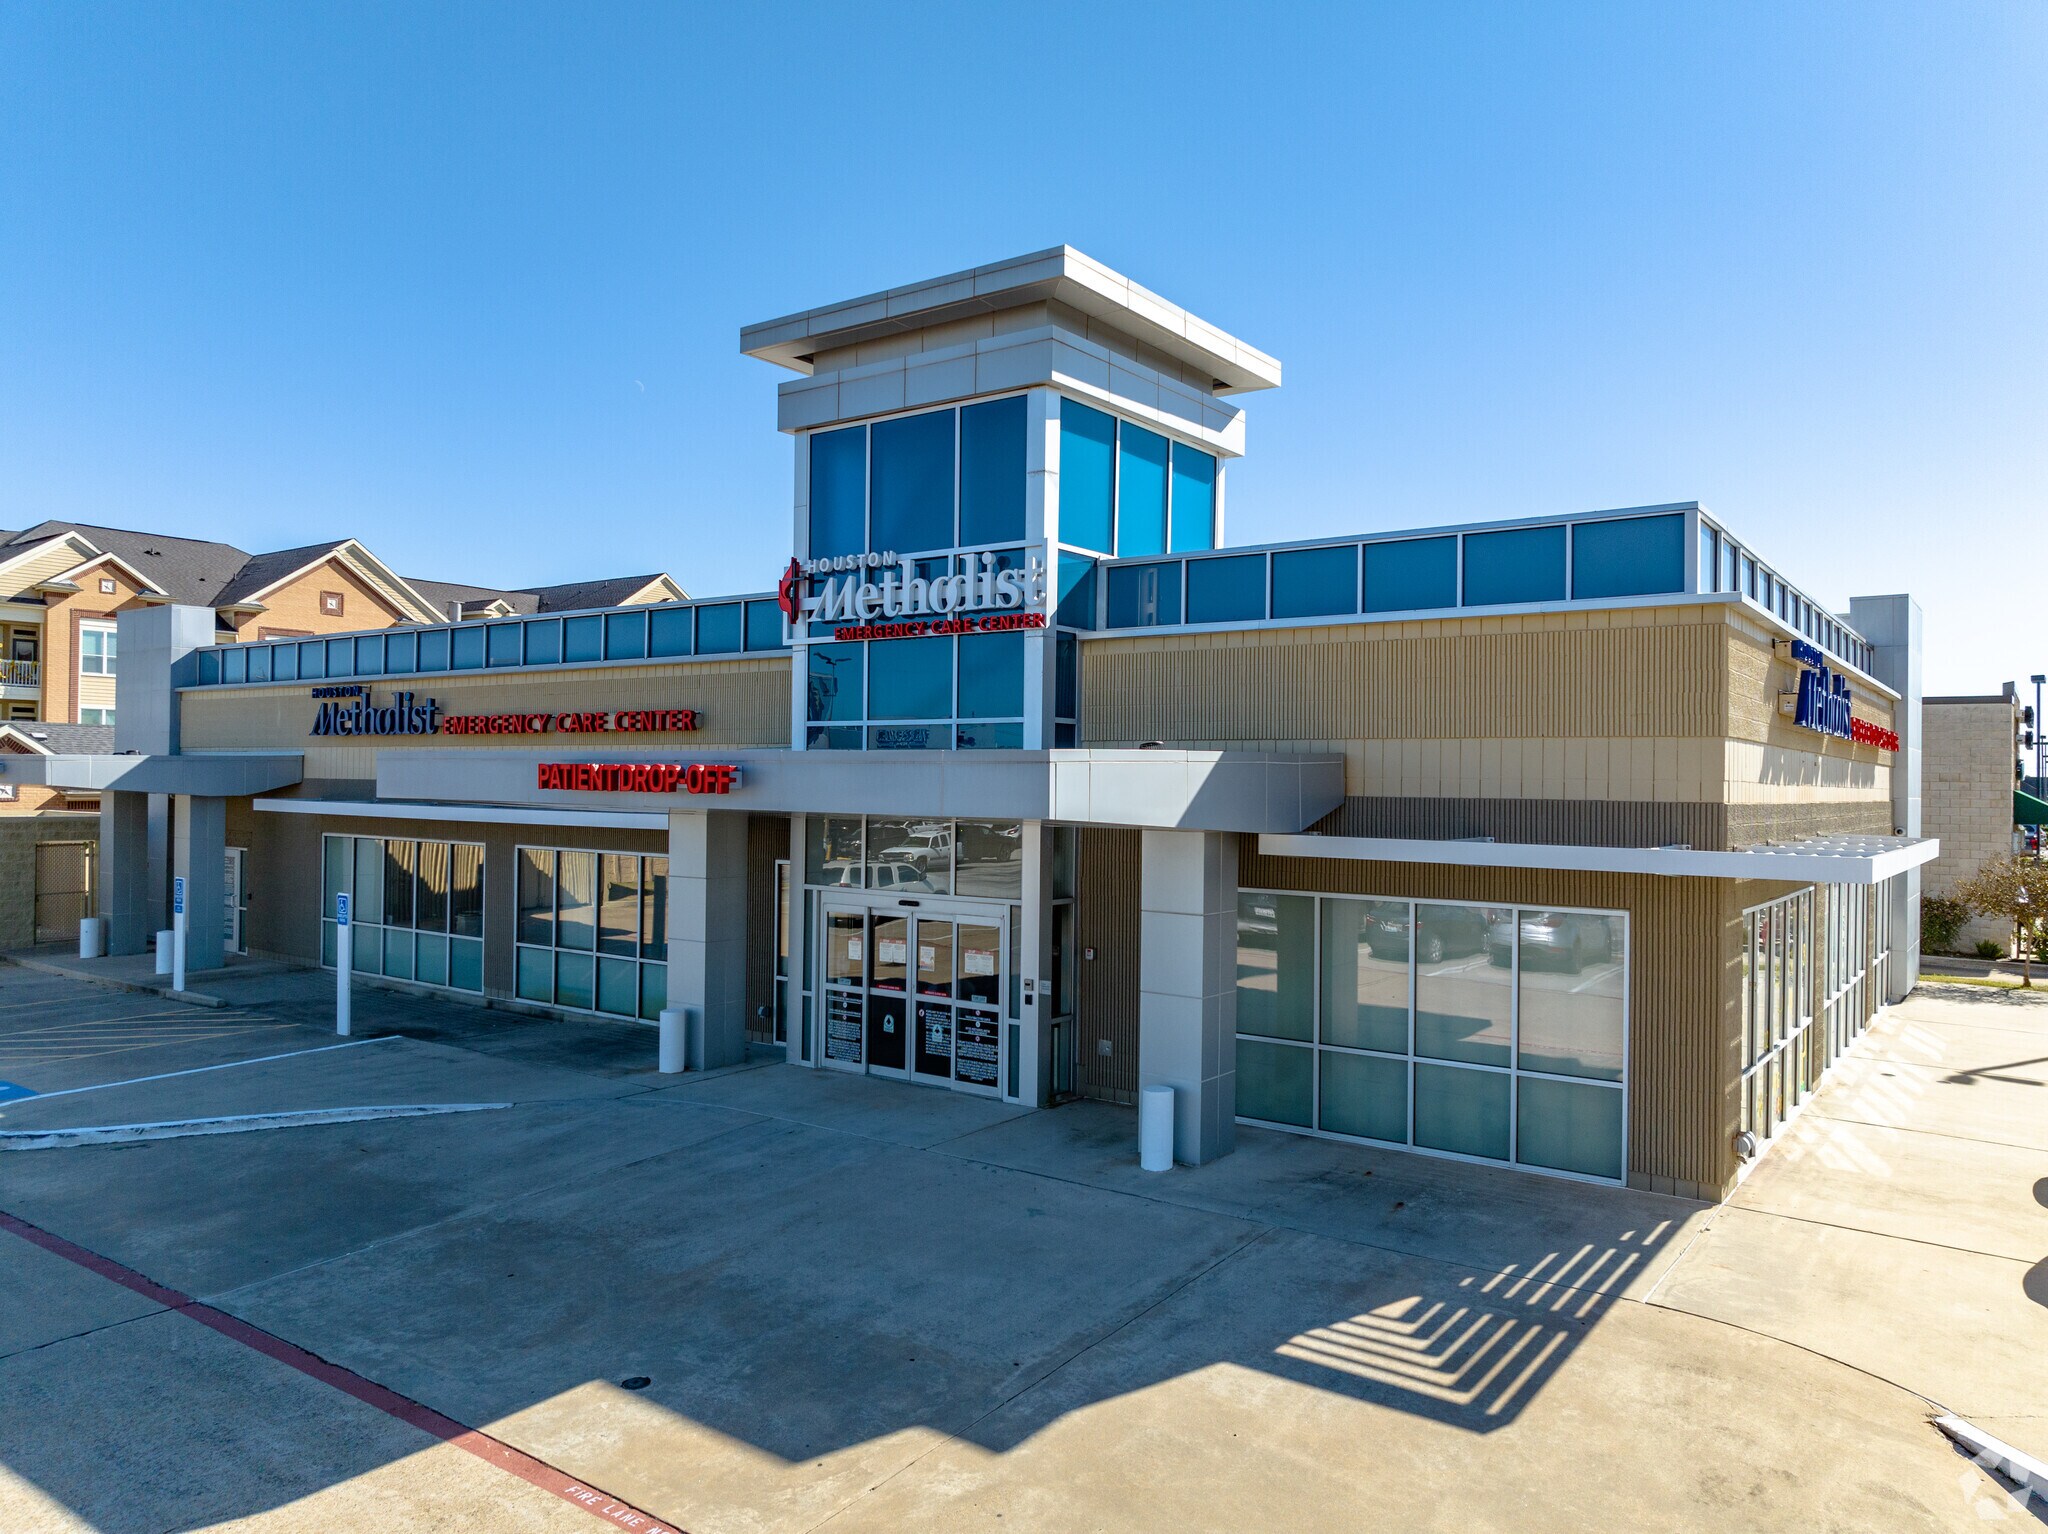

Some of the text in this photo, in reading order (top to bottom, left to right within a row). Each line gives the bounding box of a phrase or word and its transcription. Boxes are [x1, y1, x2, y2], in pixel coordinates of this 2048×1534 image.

[808, 551, 896, 573] HOUSTON
[808, 552, 1046, 622] Methodist
[834, 613, 1045, 641] EMERGENCY CARE CENTER
[312, 686, 362, 698] HOUSTON
[309, 692, 697, 736] Methodist EMERGENCY CARE CENTER
[538, 763, 733, 794] PATIENT DROP-OFF
[564, 1486, 672, 1534] FIRE LANE N
